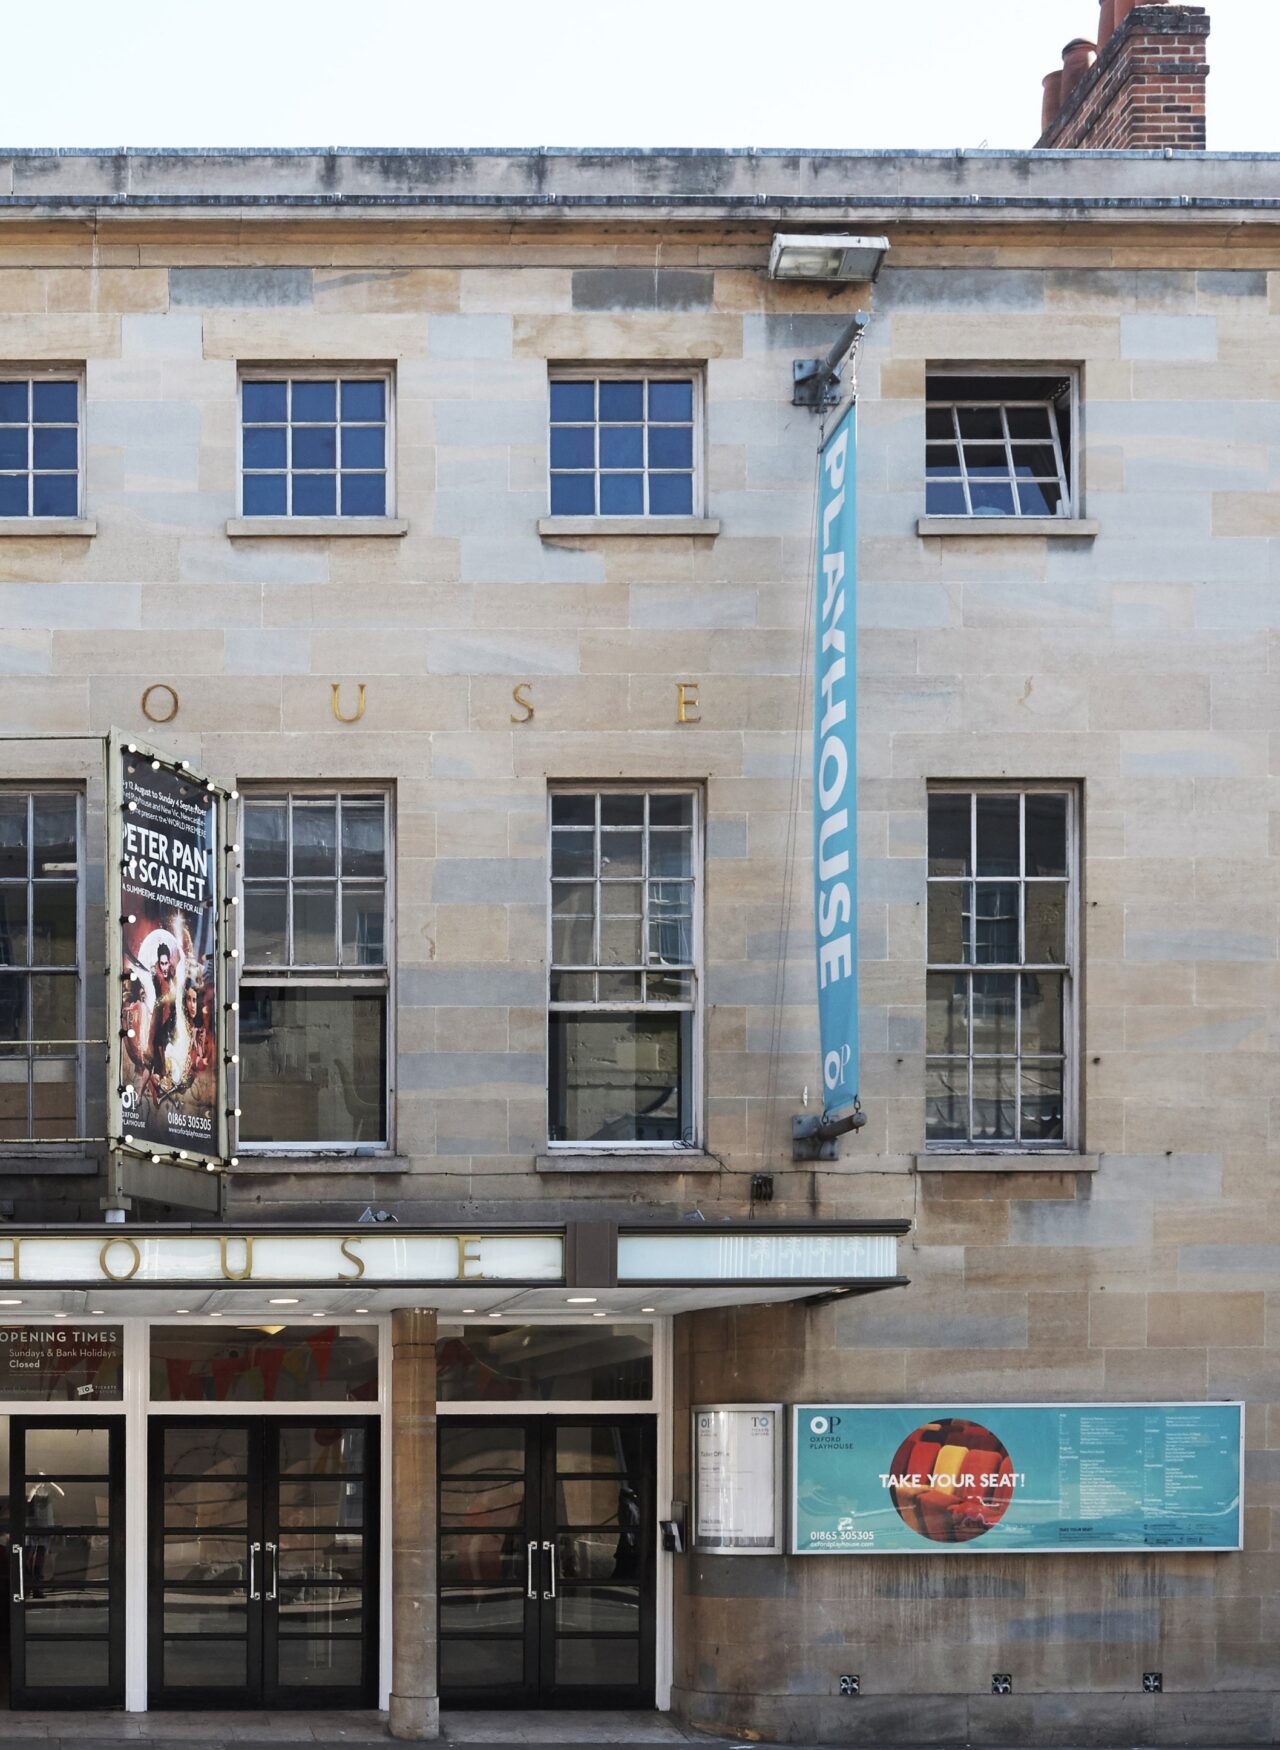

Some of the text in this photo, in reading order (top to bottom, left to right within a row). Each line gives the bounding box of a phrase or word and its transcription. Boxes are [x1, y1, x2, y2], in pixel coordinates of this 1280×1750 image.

[819, 427, 852, 989] PLAYHOUSE
[134, 783, 152, 797] August
[152, 790, 158, 799] to
[158, 792, 175, 807] Sunday
[152, 803, 160, 812] and
[161, 805, 172, 815] New
[166, 818, 185, 830] WORLD
[172, 839, 208, 877] PAN
[139, 858, 206, 902] SCARLET
[126, 884, 156, 900] SUMMERTIME
[156, 894, 182, 910] ADVENTURE
[184, 902, 194, 912] FOR
[824, 1044, 850, 1090] OP
[122, 1112, 140, 1120] OXFORD
[168, 1112, 211, 1130] 01865 305305
[72, 1332, 117, 1342] TIMES
[9, 1348, 116, 1358] Sundays & Bank Holidays
[9, 1360, 40, 1368] Closed
[752, 1416, 768, 1427] TO
[810, 1416, 840, 1434] OP
[879, 1474, 1024, 1488] TAKE YOUR SEAT!
[810, 1531, 874, 1540] 01865 305305
